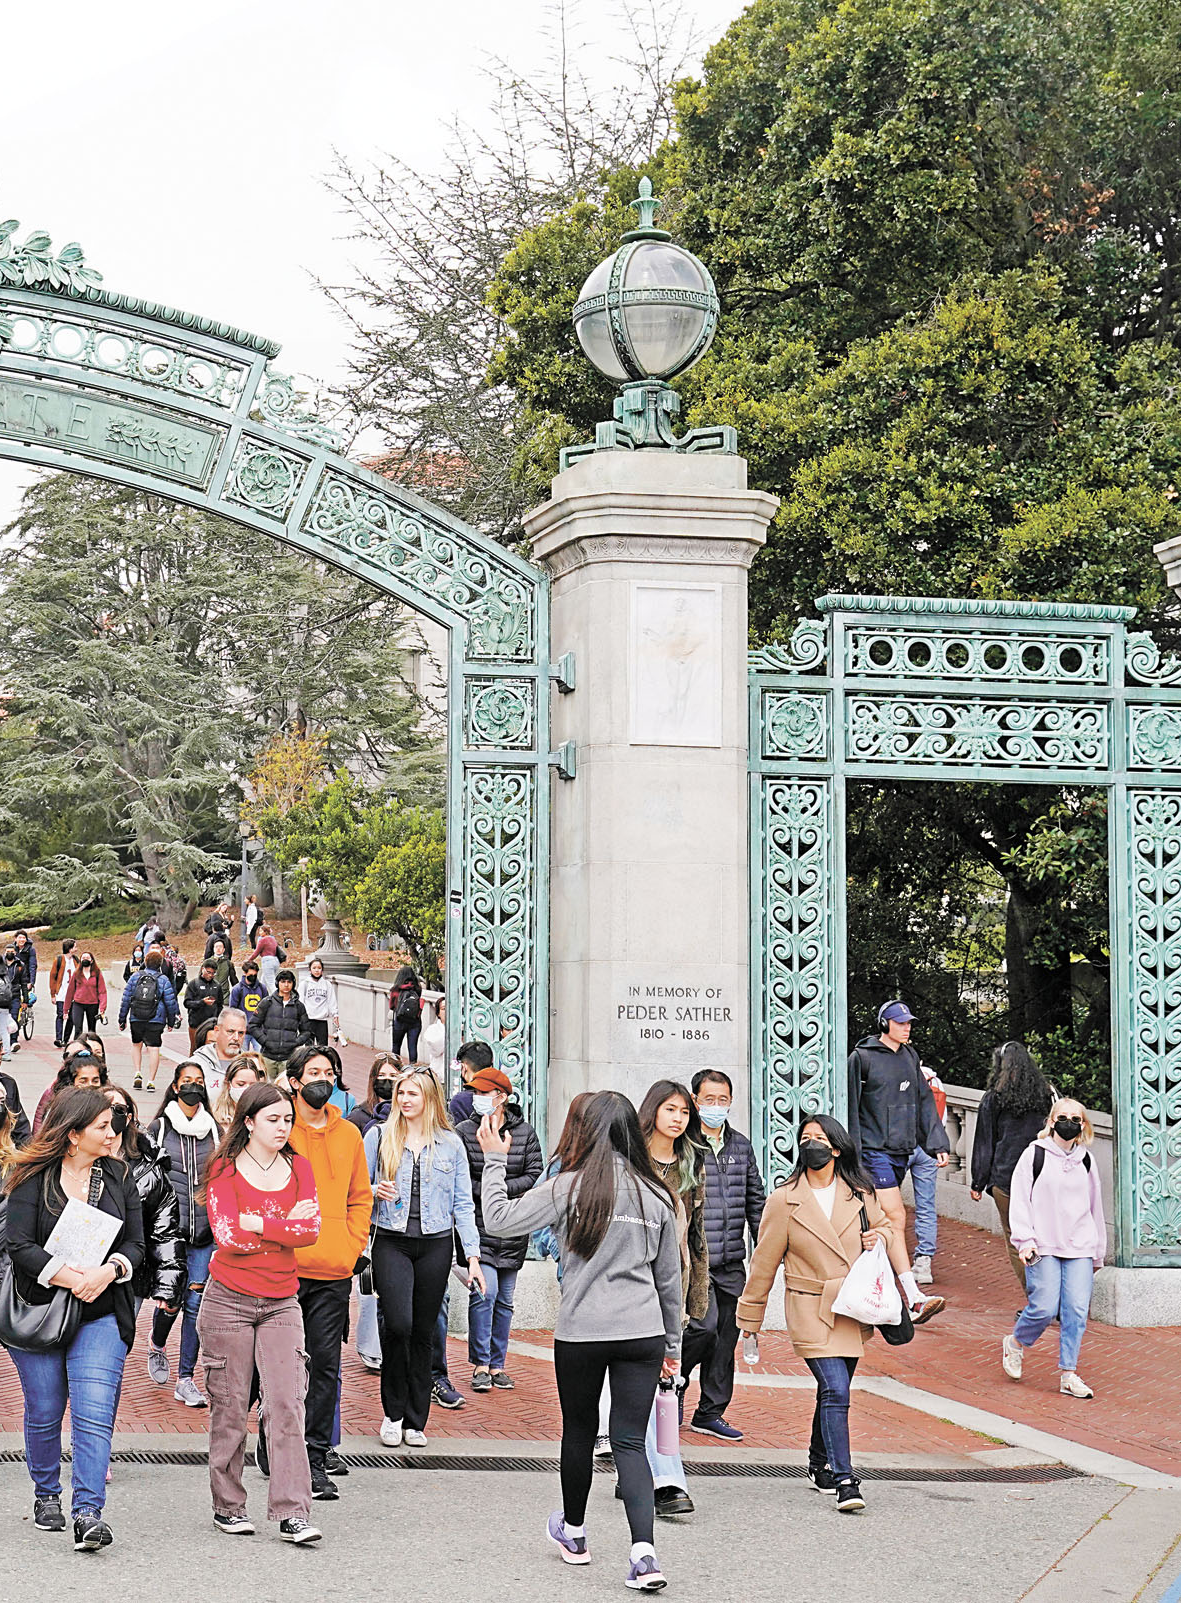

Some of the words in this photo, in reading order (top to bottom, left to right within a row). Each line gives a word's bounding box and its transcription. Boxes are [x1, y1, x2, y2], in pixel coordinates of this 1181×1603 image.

[628, 986, 640, 996] IN
[646, 987, 700, 998] MEMORY
[705, 988, 722, 999] OF
[617, 1005, 669, 1020] PEDER
[675, 1006, 733, 1022] SATHER
[640, 1028, 664, 1039] 1810
[682, 1029, 710, 1041] 1886
